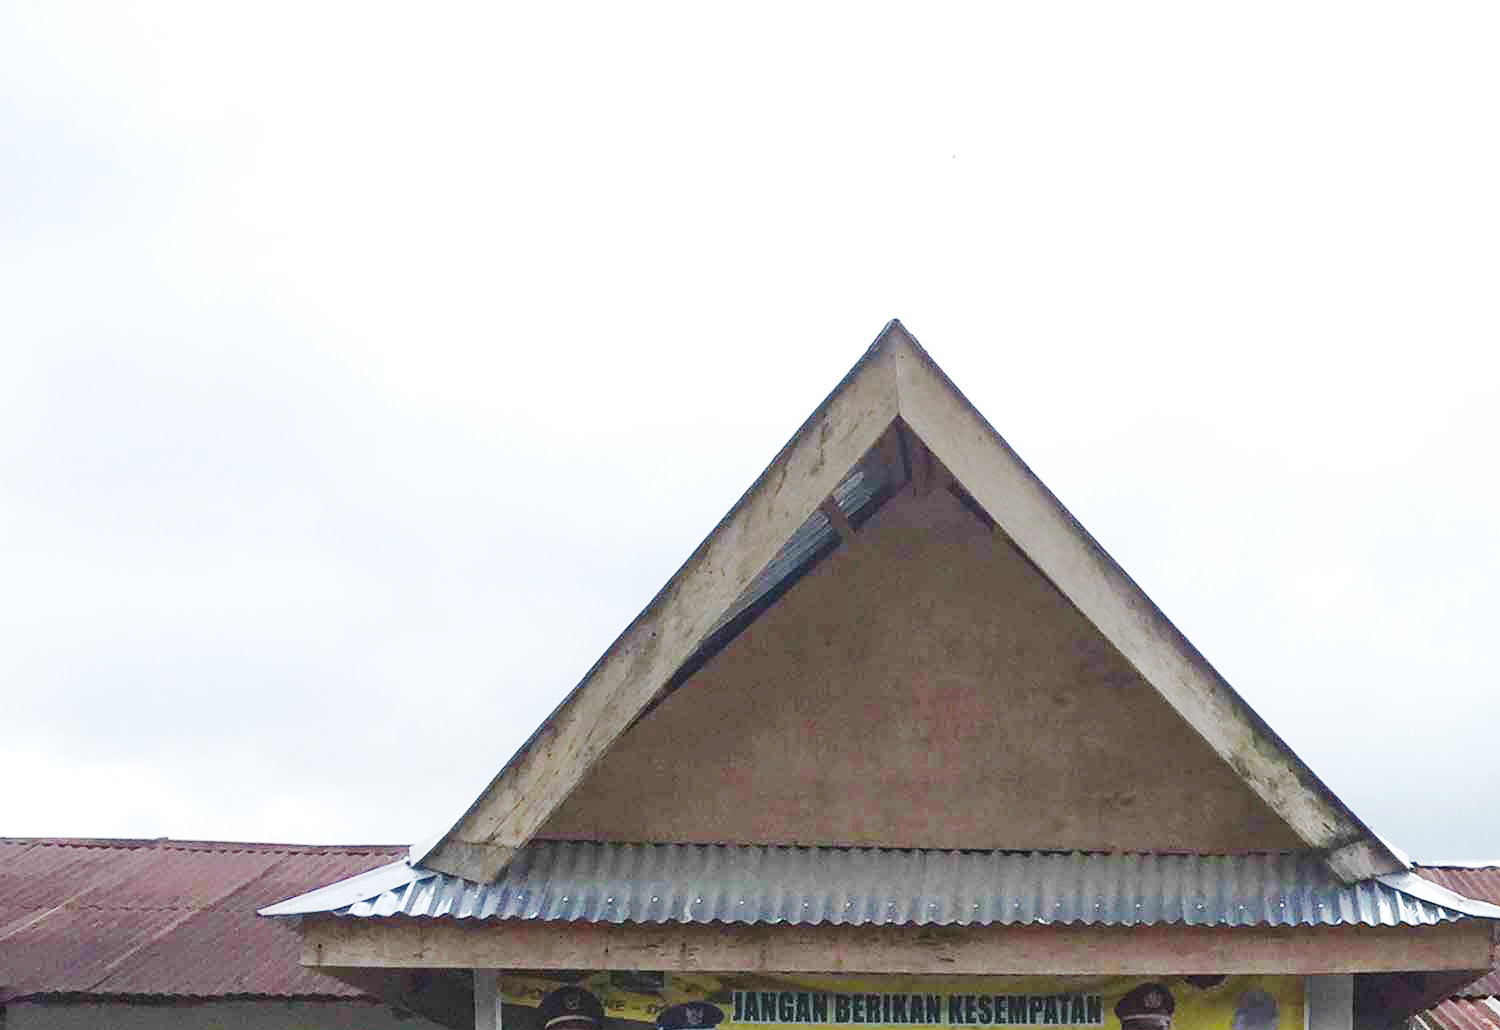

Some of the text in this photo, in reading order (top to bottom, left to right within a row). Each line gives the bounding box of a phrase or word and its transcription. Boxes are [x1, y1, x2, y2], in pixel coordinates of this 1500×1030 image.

[731, 991, 1103, 1025] JANGAN BERIKAN KESEMPATAN
